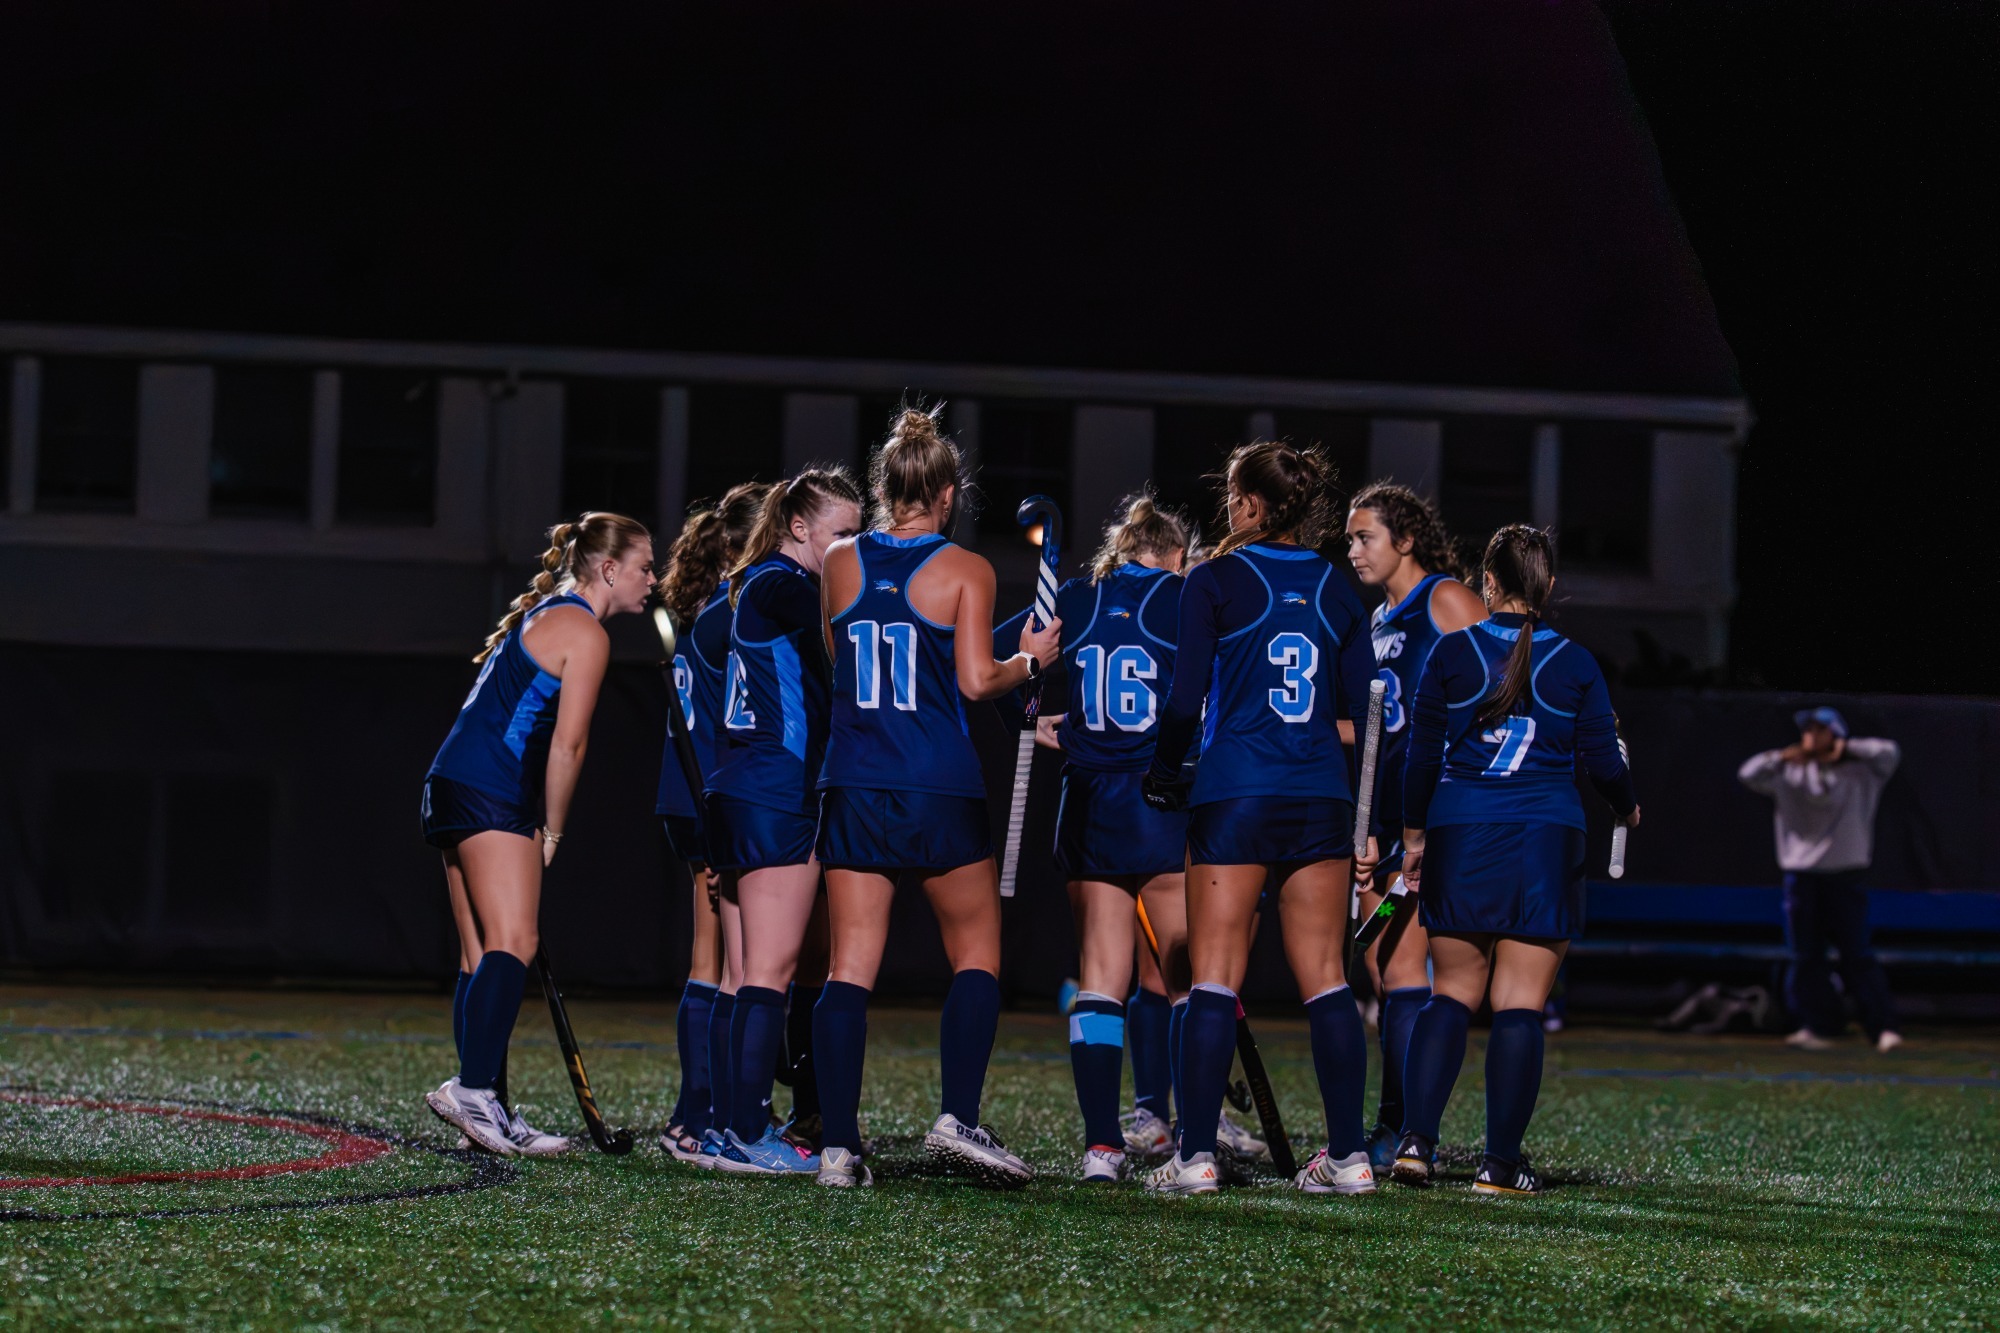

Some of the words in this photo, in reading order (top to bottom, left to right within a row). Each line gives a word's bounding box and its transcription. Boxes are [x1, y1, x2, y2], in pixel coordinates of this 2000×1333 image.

[848, 620, 917, 711] 11
[1075, 644, 1158, 732] 16
[1268, 632, 1319, 723] 3
[1480, 714, 1536, 777] 7
[956, 1123, 996, 1150] OSAKA
